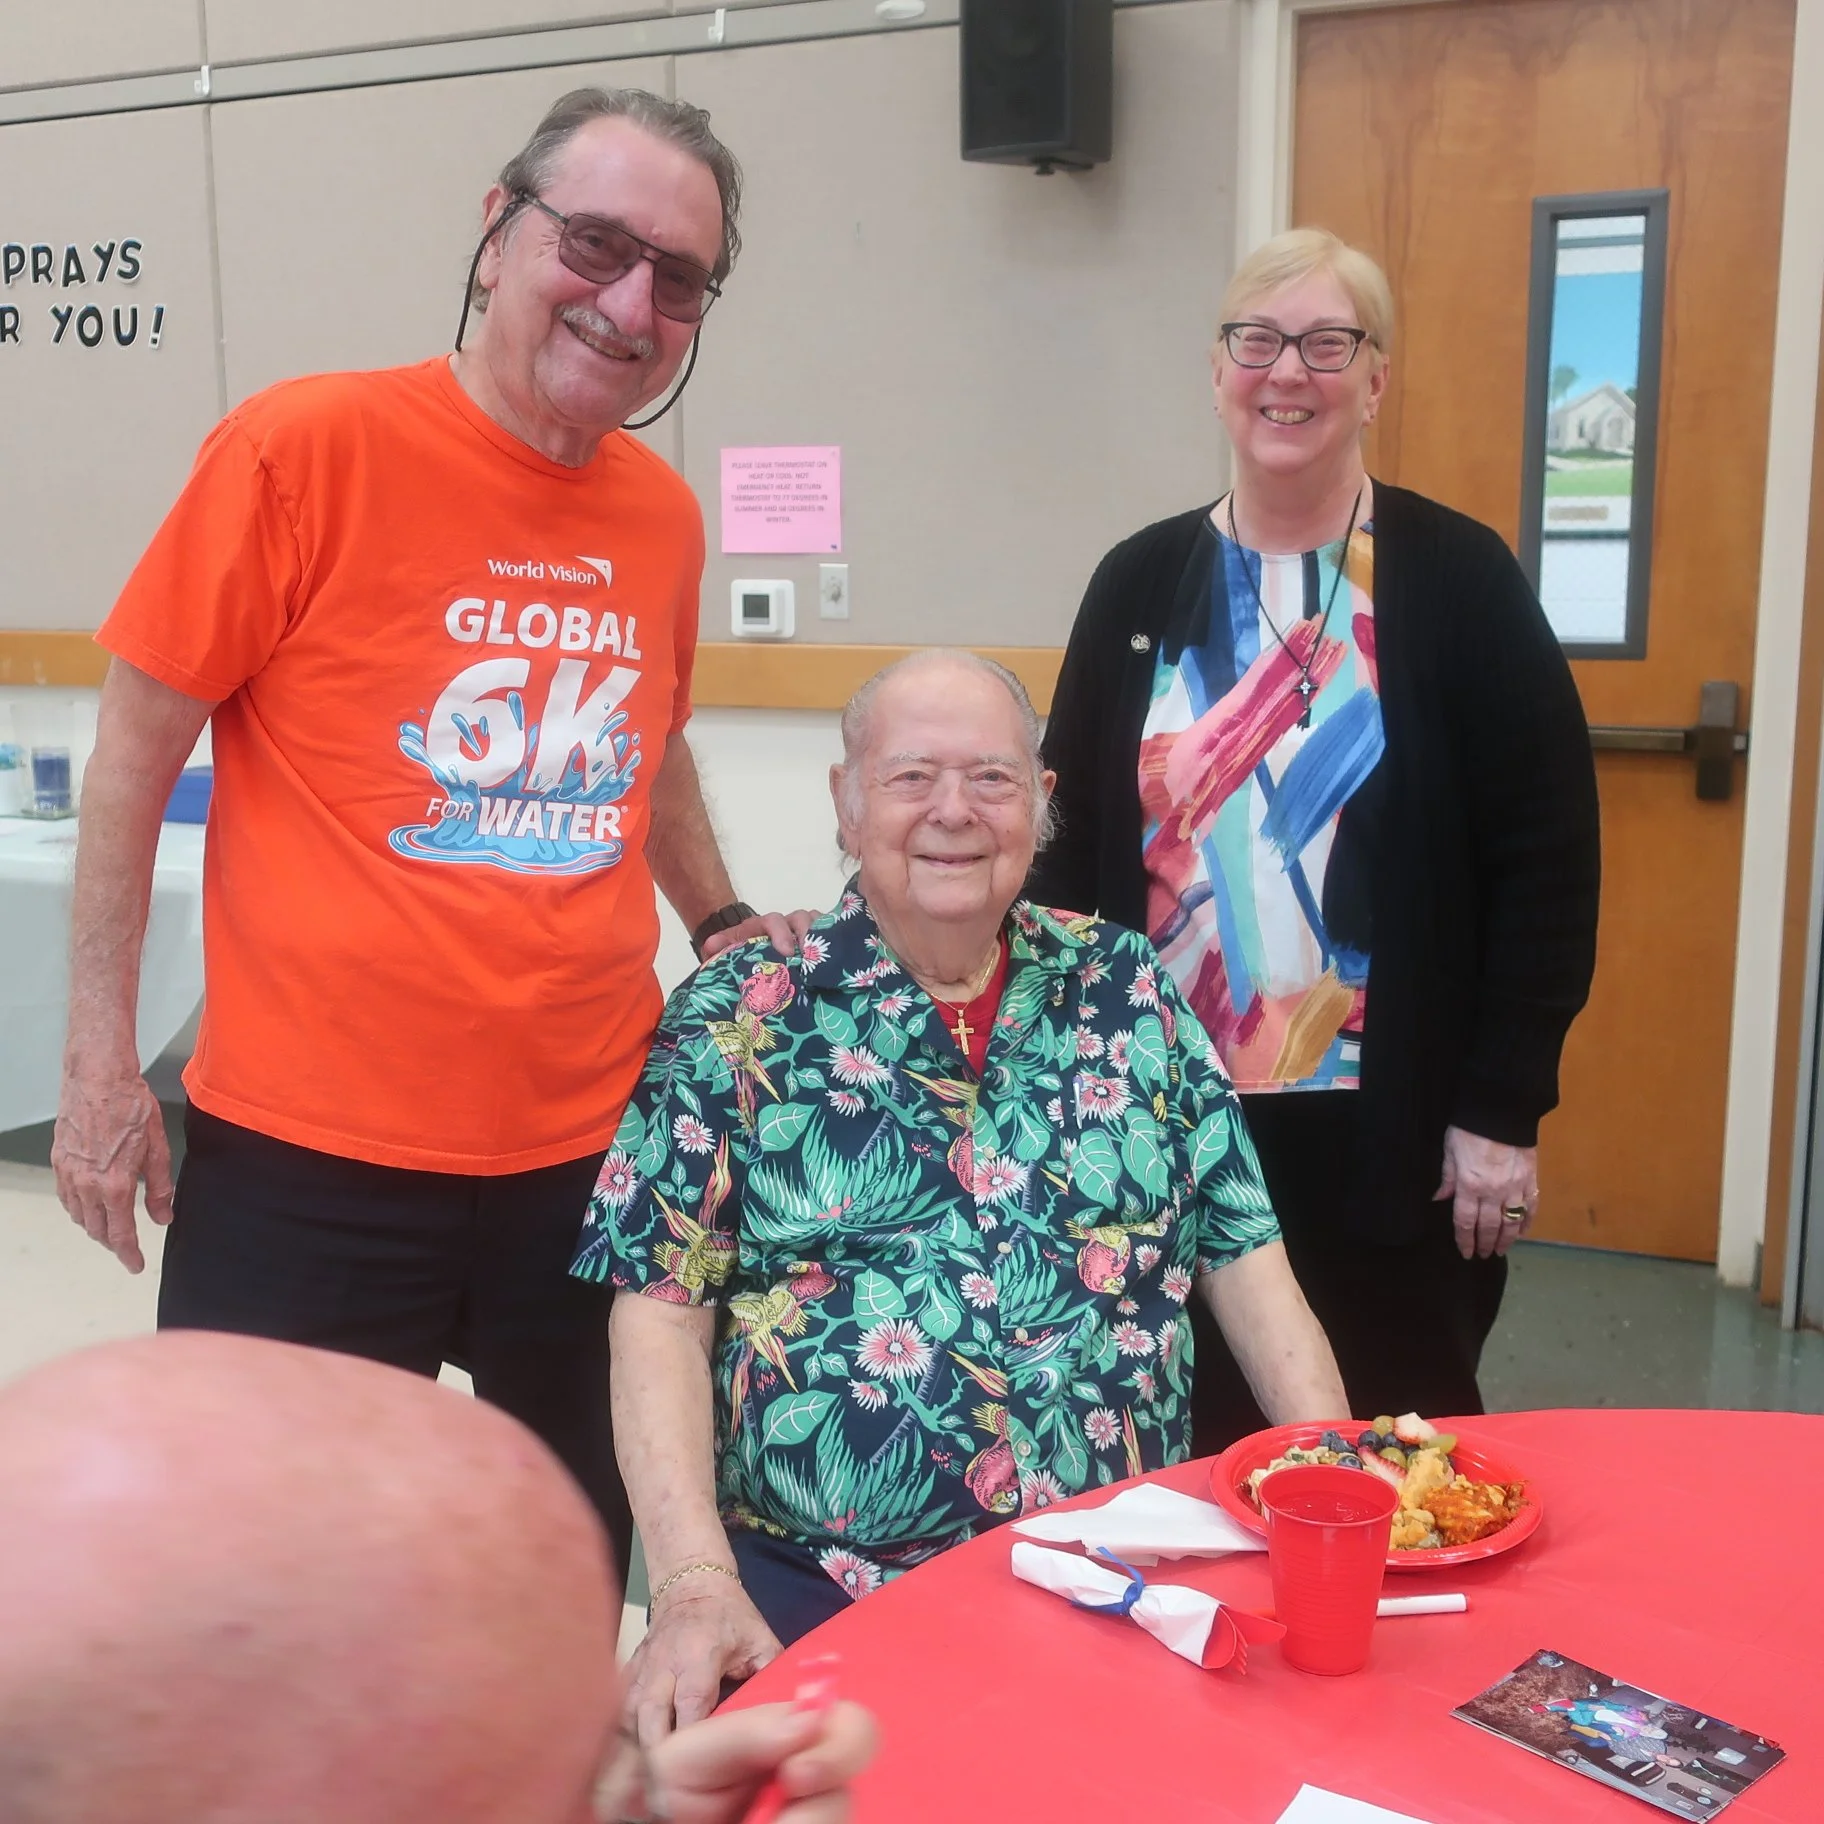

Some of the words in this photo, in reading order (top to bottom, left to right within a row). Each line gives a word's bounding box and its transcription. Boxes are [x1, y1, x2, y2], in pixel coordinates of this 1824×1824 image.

[2, 238, 142, 288] PRAYS
[51, 305, 164, 347] YOU!
[487, 559, 544, 579] World
[548, 564, 597, 586] Vision
[445, 597, 642, 661] GLOBAL
[426, 657, 642, 792] 6K
[425, 797, 474, 822] FOR
